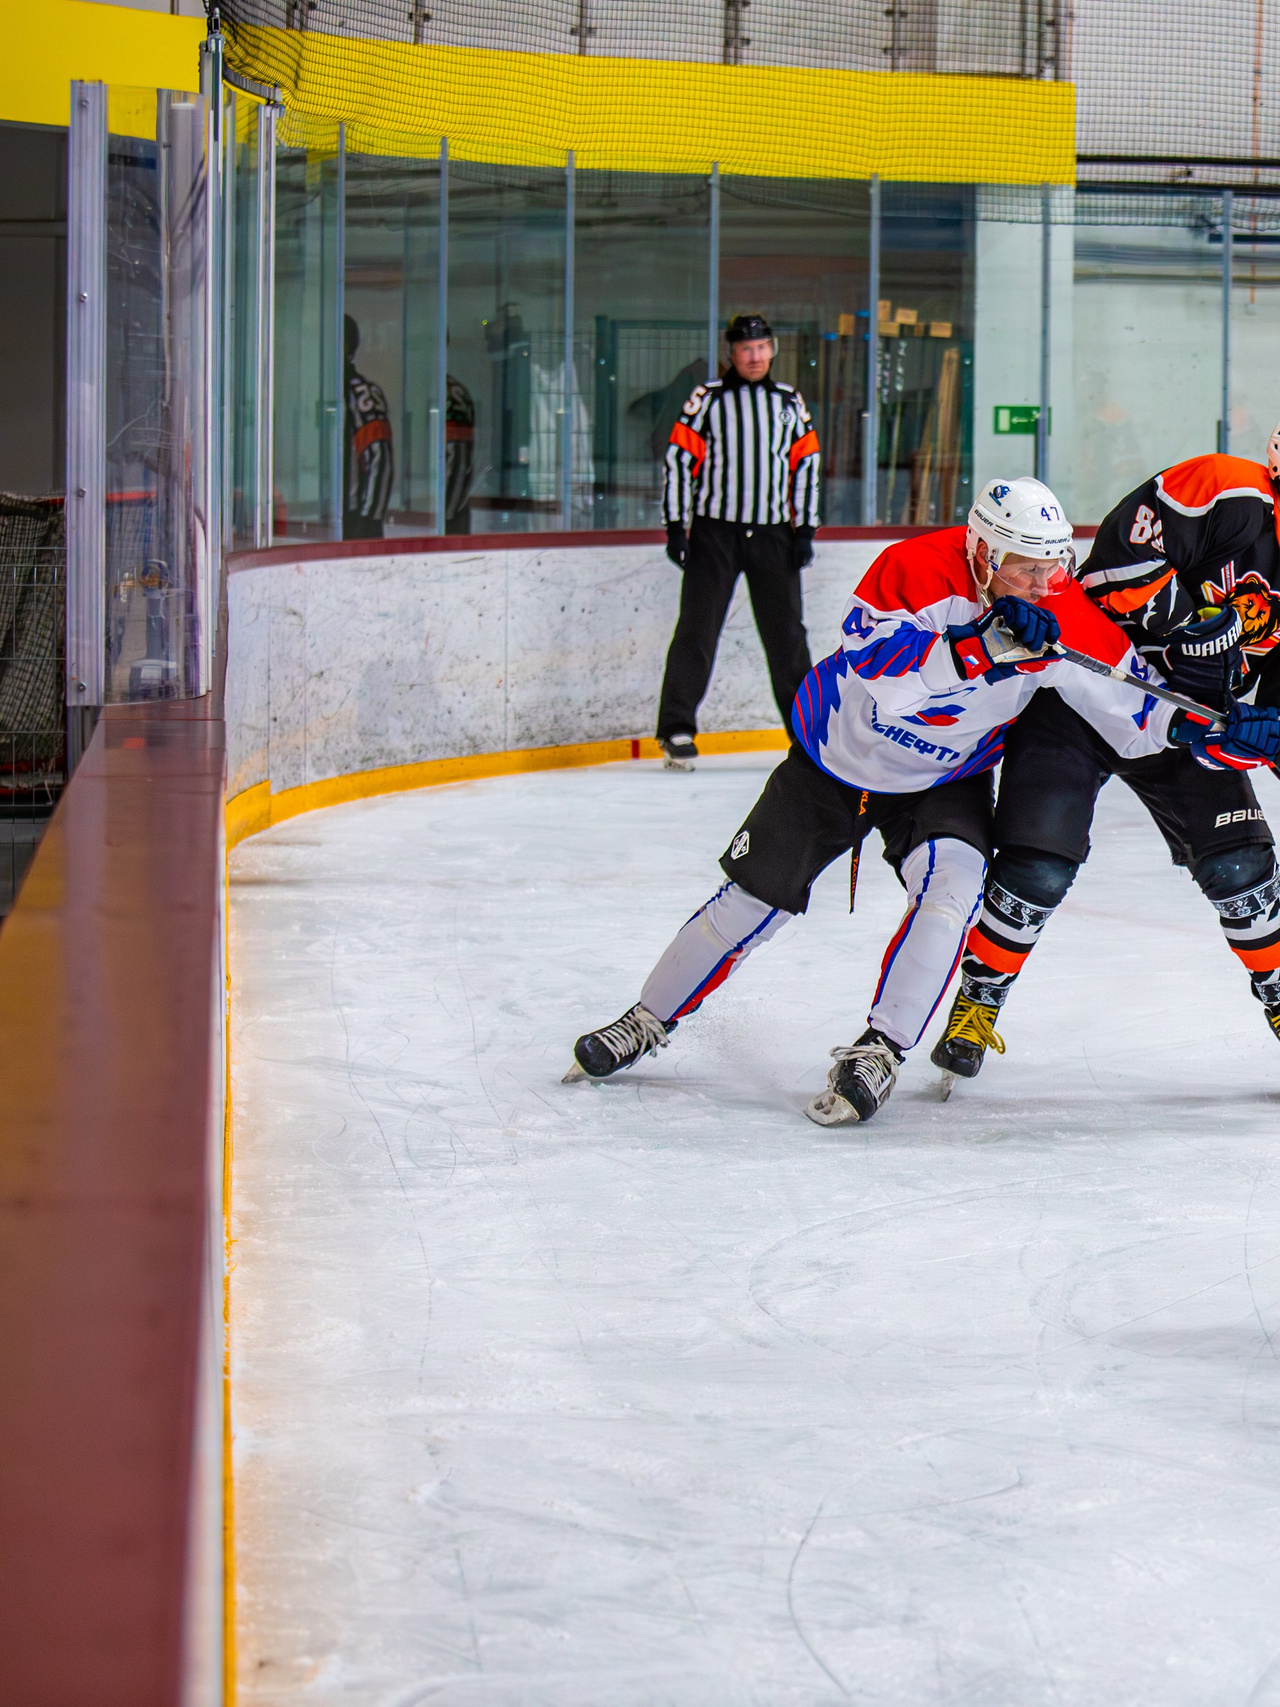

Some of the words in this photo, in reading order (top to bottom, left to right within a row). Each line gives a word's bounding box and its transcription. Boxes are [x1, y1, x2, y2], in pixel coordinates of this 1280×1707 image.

[1040, 506, 1060, 522] 47
[841, 605, 891, 641] 4
[870, 706, 961, 763] СНЕФТ
